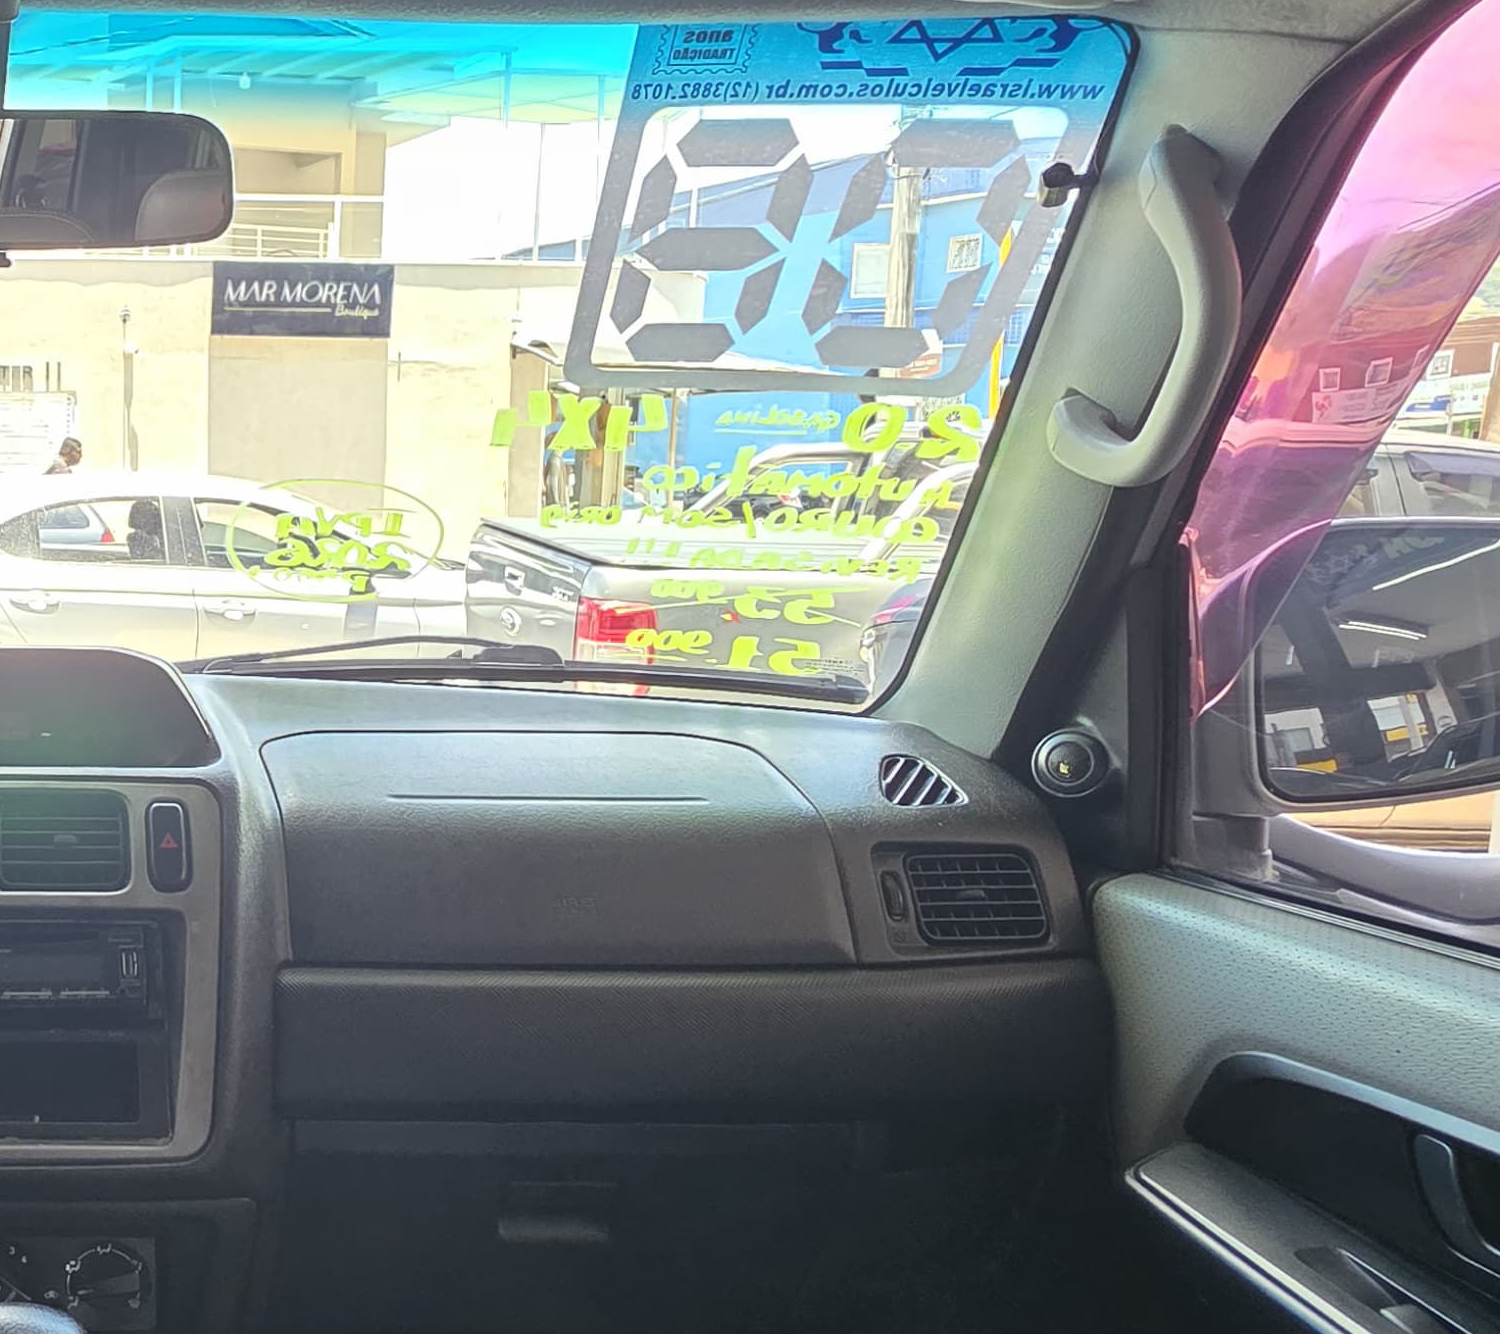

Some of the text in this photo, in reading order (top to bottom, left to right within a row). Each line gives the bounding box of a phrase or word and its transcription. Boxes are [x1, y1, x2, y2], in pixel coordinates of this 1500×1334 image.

[224, 279, 381, 305] MAR MORENA
[334, 303, 380, 320] Boutique
